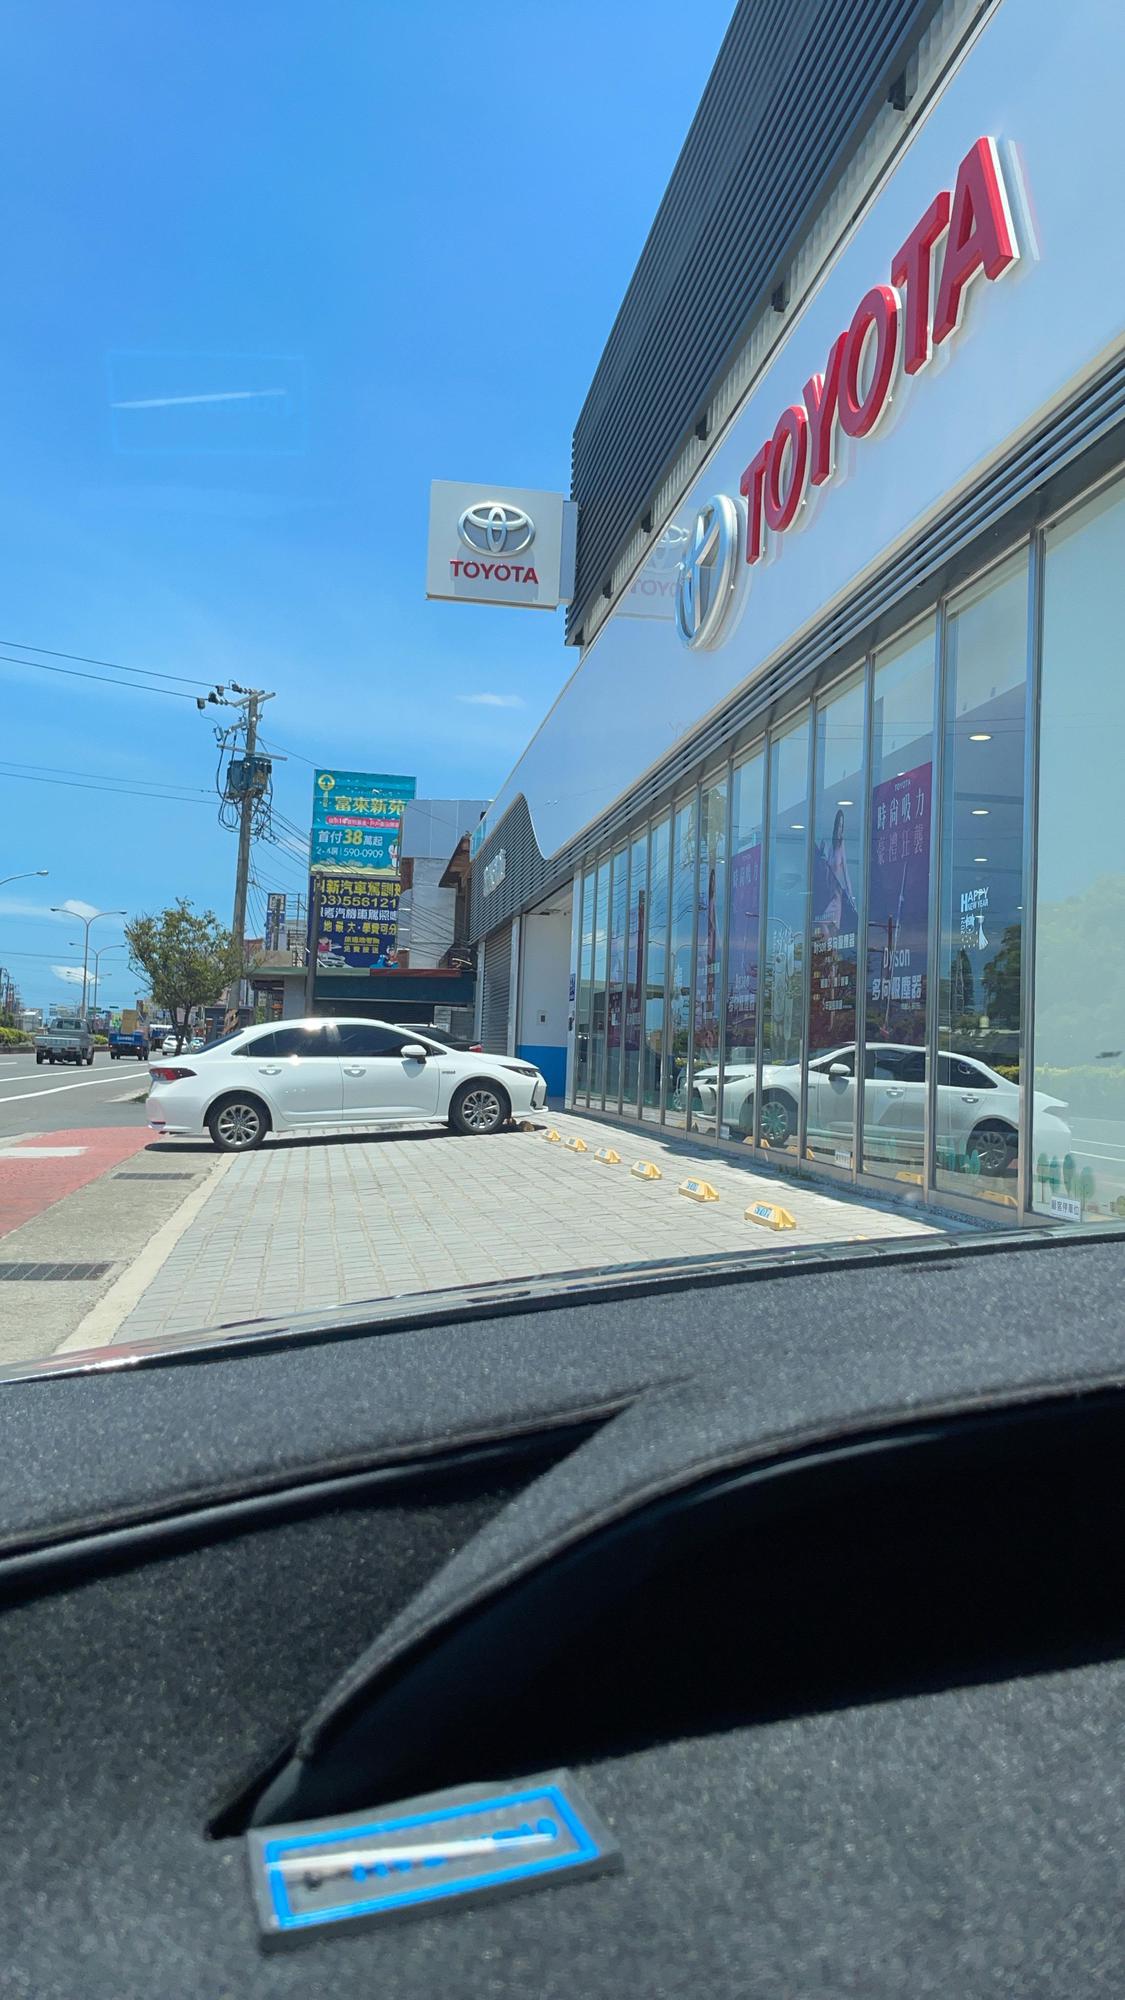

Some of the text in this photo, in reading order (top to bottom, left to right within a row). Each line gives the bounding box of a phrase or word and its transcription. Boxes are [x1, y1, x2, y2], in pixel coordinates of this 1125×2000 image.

[740, 136, 1019, 565] TOYOTA
[450, 560, 539, 585] TOYOTA
[877, 788, 924, 830] 時尚吸力
[318, 829, 383, 847] 首付38萬起
[343, 847, 384, 858] 590-0909
[960, 887, 989, 912] HAPPY
[883, 947, 911, 971] Dyson
[872, 974, 922, 1001] 多向吸塵器
